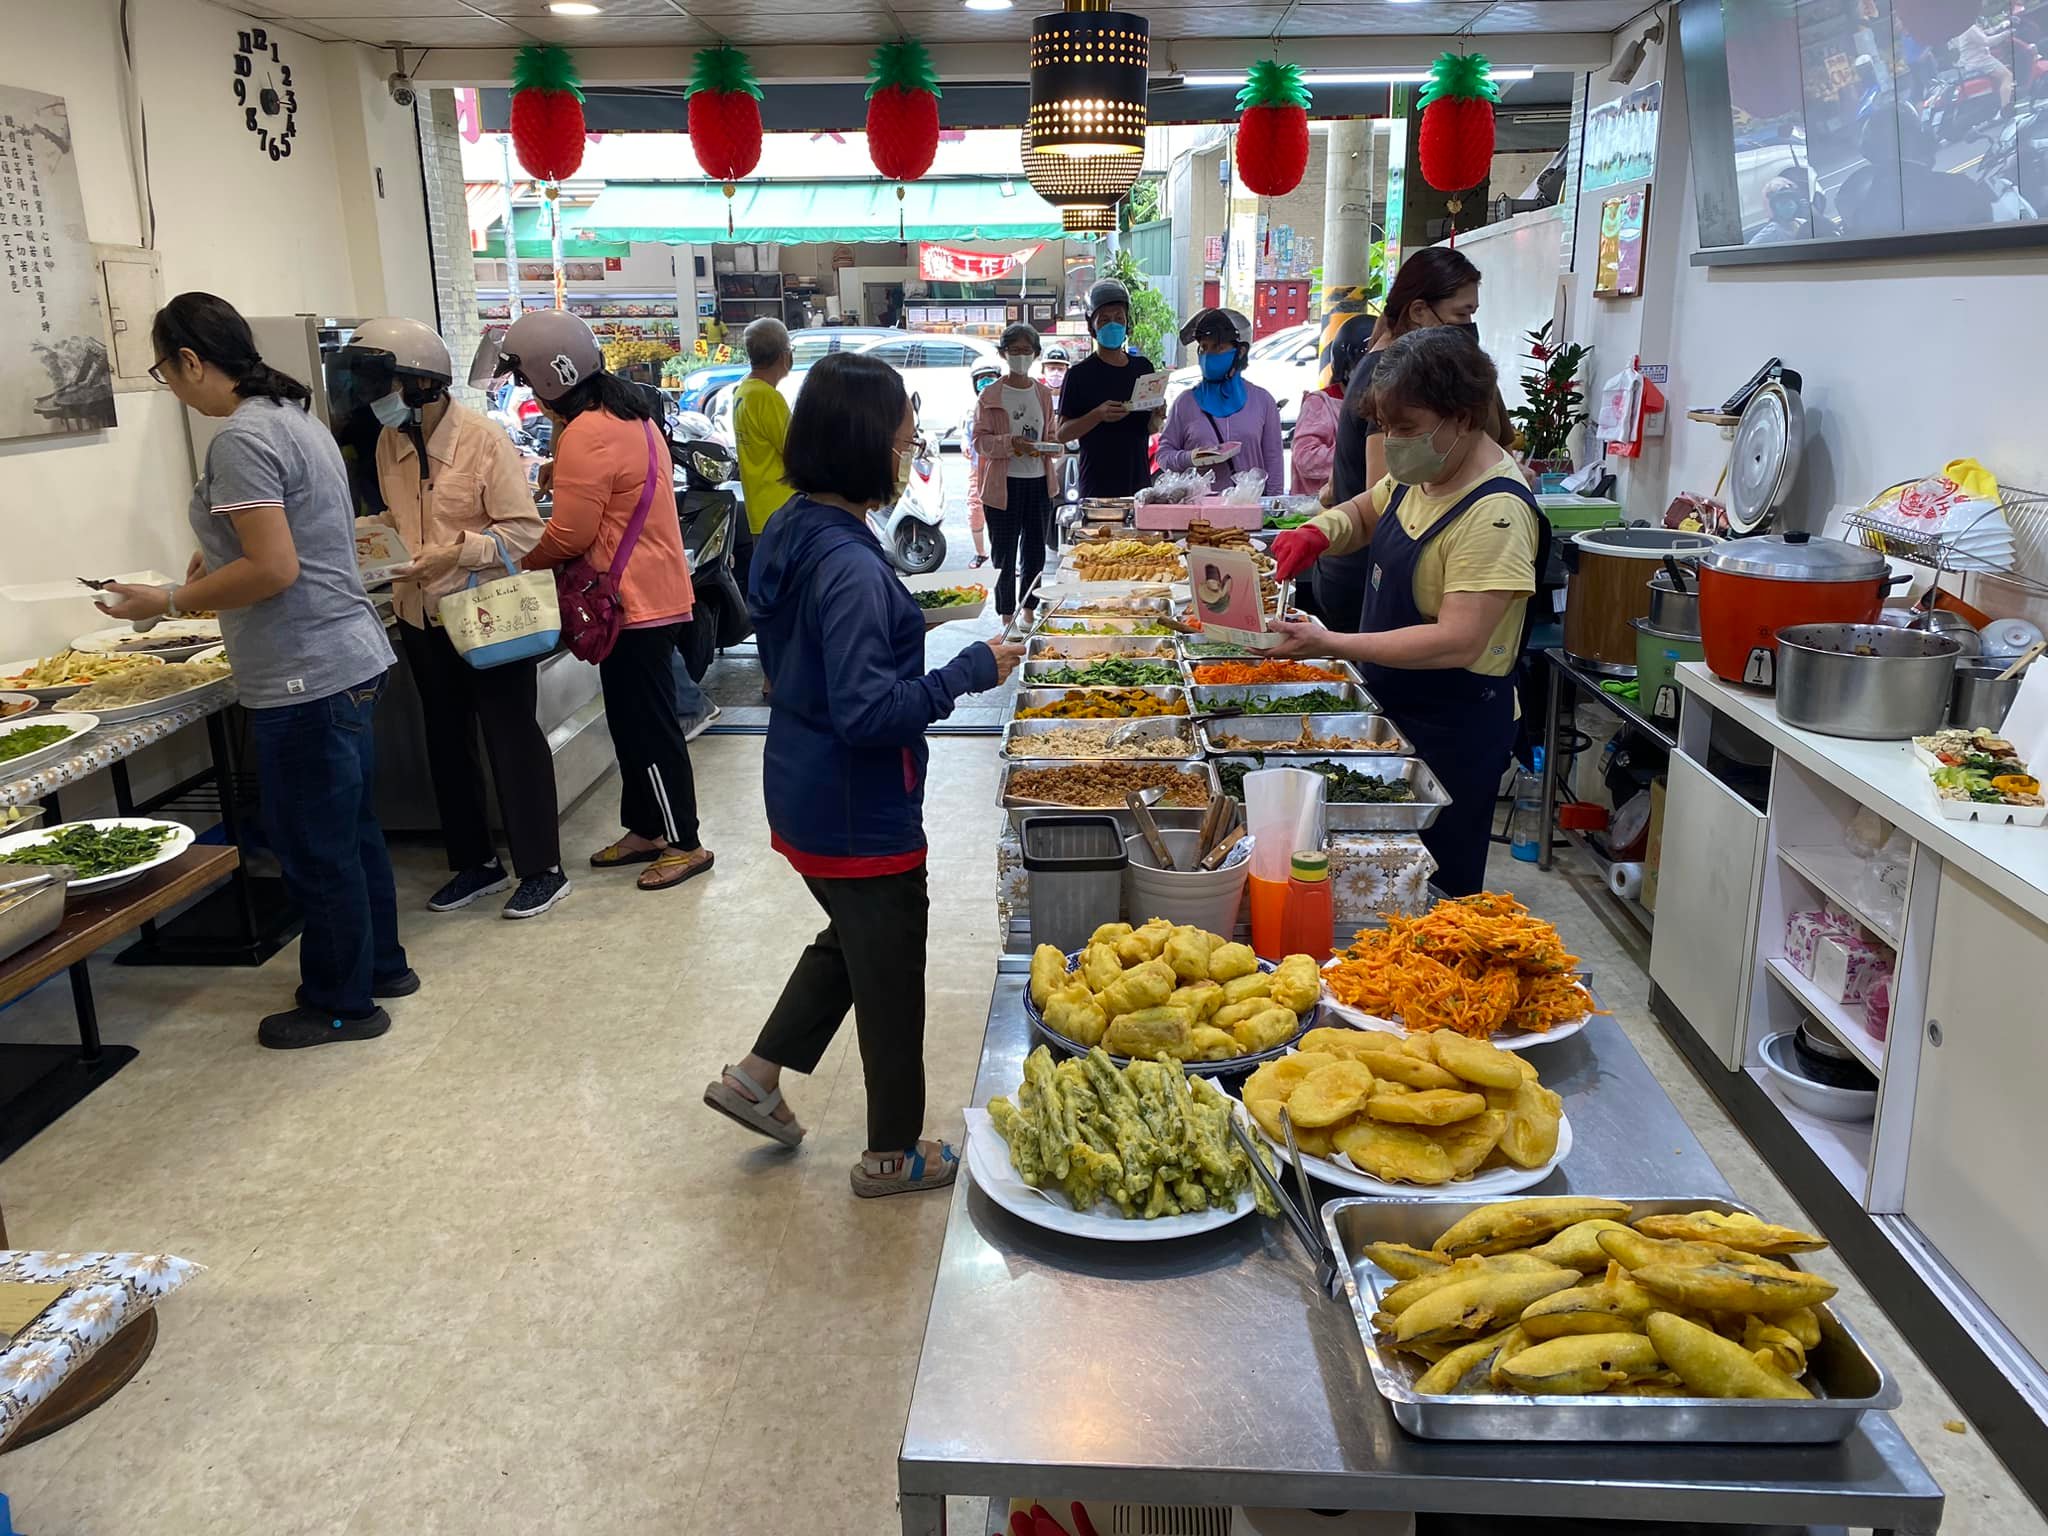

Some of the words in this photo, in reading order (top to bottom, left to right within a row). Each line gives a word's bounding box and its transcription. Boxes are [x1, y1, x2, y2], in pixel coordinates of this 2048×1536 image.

[237, 31, 253, 54] 11
[252, 28, 268, 51] 12
[270, 43, 280, 63] 1
[233, 54, 252, 77] 10
[281, 65, 292, 86] 2
[233, 78, 246, 106] 9
[286, 90, 297, 113] 3
[246, 107, 257, 131] 8
[286, 113, 296, 137] 4
[257, 128, 267, 151] 7
[269, 137, 280, 161] 6
[280, 132, 291, 157] 5
